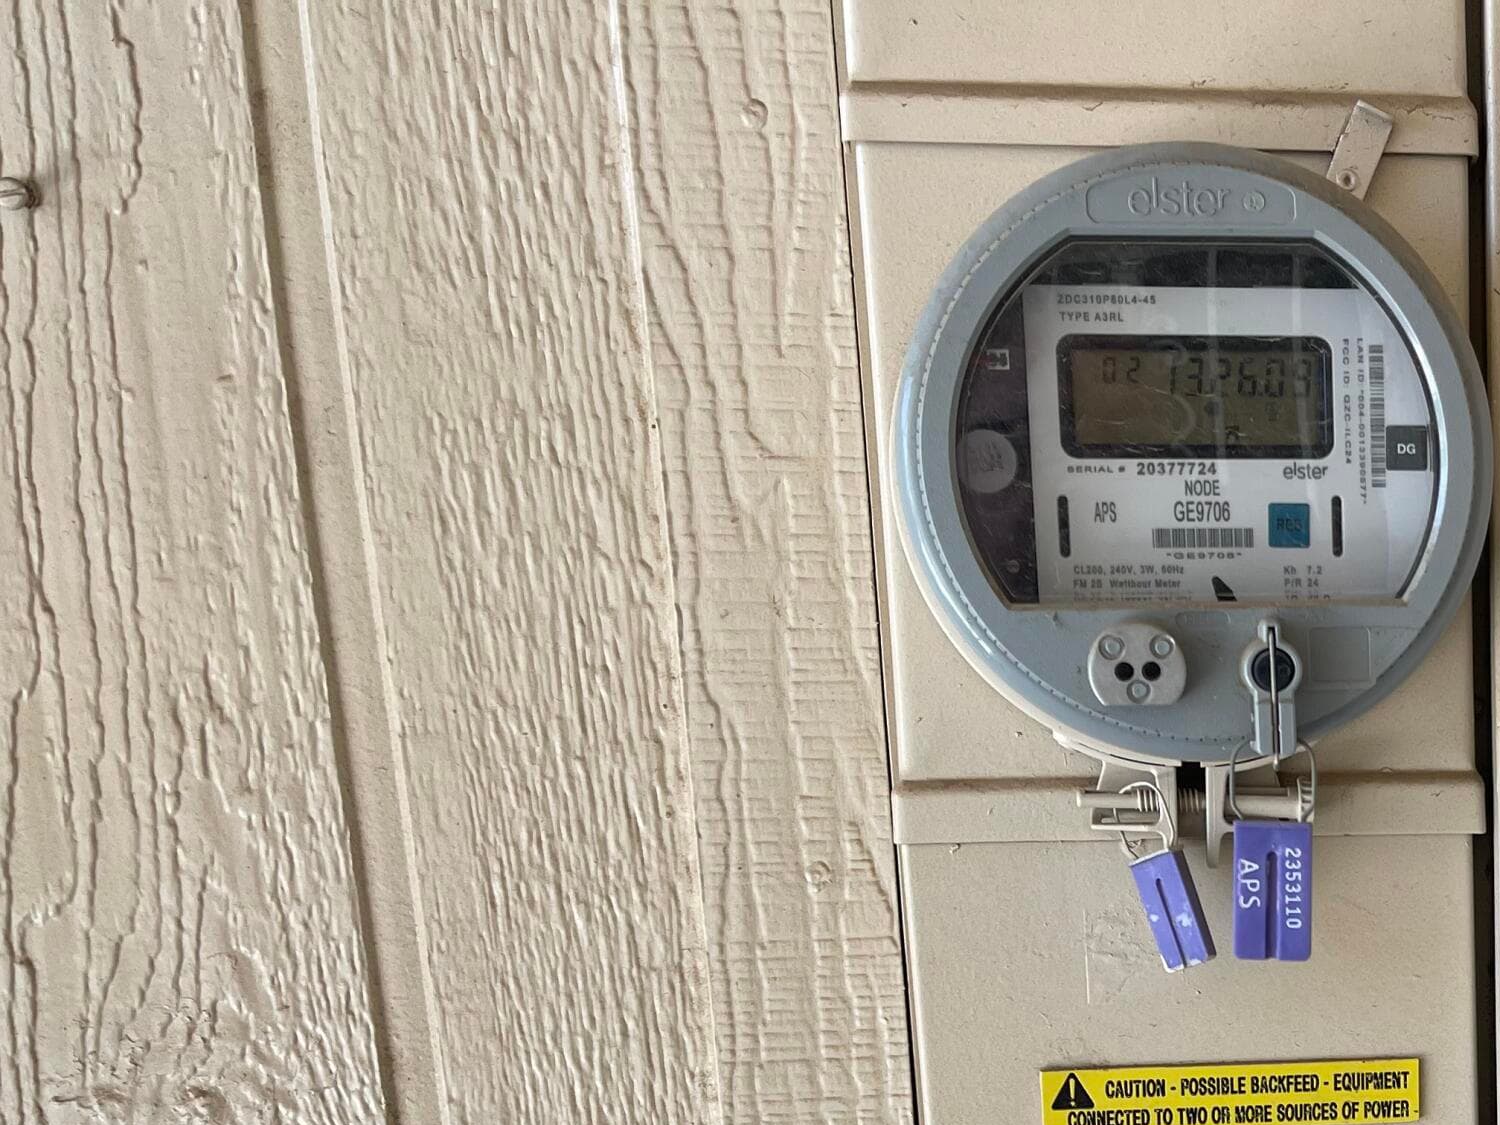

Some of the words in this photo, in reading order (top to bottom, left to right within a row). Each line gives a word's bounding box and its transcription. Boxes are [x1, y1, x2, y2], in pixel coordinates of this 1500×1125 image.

[1127, 175, 1232, 217] elster
[1059, 311, 1090, 322] TYPE
[1094, 311, 1124, 322] A3RL
[1342, 338, 1350, 365] FCC
[1396, 443, 1416, 455] DG
[1067, 465, 1113, 474] SERIAL
[1136, 462, 1217, 476] 20377724
[1282, 462, 1329, 481] elster
[1184, 479, 1221, 497] NODE
[1094, 501, 1118, 523] APS
[1173, 501, 1231, 522] GE9706
[1073, 579, 1087, 589] FM
[1155, 579, 1181, 589] Meter
[1307, 577, 1320, 588] 24
[1238, 858, 1261, 910] APS
[1284, 847, 1302, 929] 2353110
[1104, 1078, 1166, 1099] CAUTION
[1180, 1077, 1246, 1097] POSSIBLE
[1250, 1074, 1320, 1094] BACKFEED
[1333, 1071, 1410, 1092] EQUIPMENT
[1154, 1108, 1174, 1125] TO
[1177, 1106, 1208, 1125] TWO
[1211, 1106, 1231, 1125] OR
[1234, 1104, 1273, 1124] MORE
[1276, 1102, 1338, 1122] SOURCES
[1341, 1101, 1360, 1120] OF
[1363, 1100, 1410, 1119] POWER
